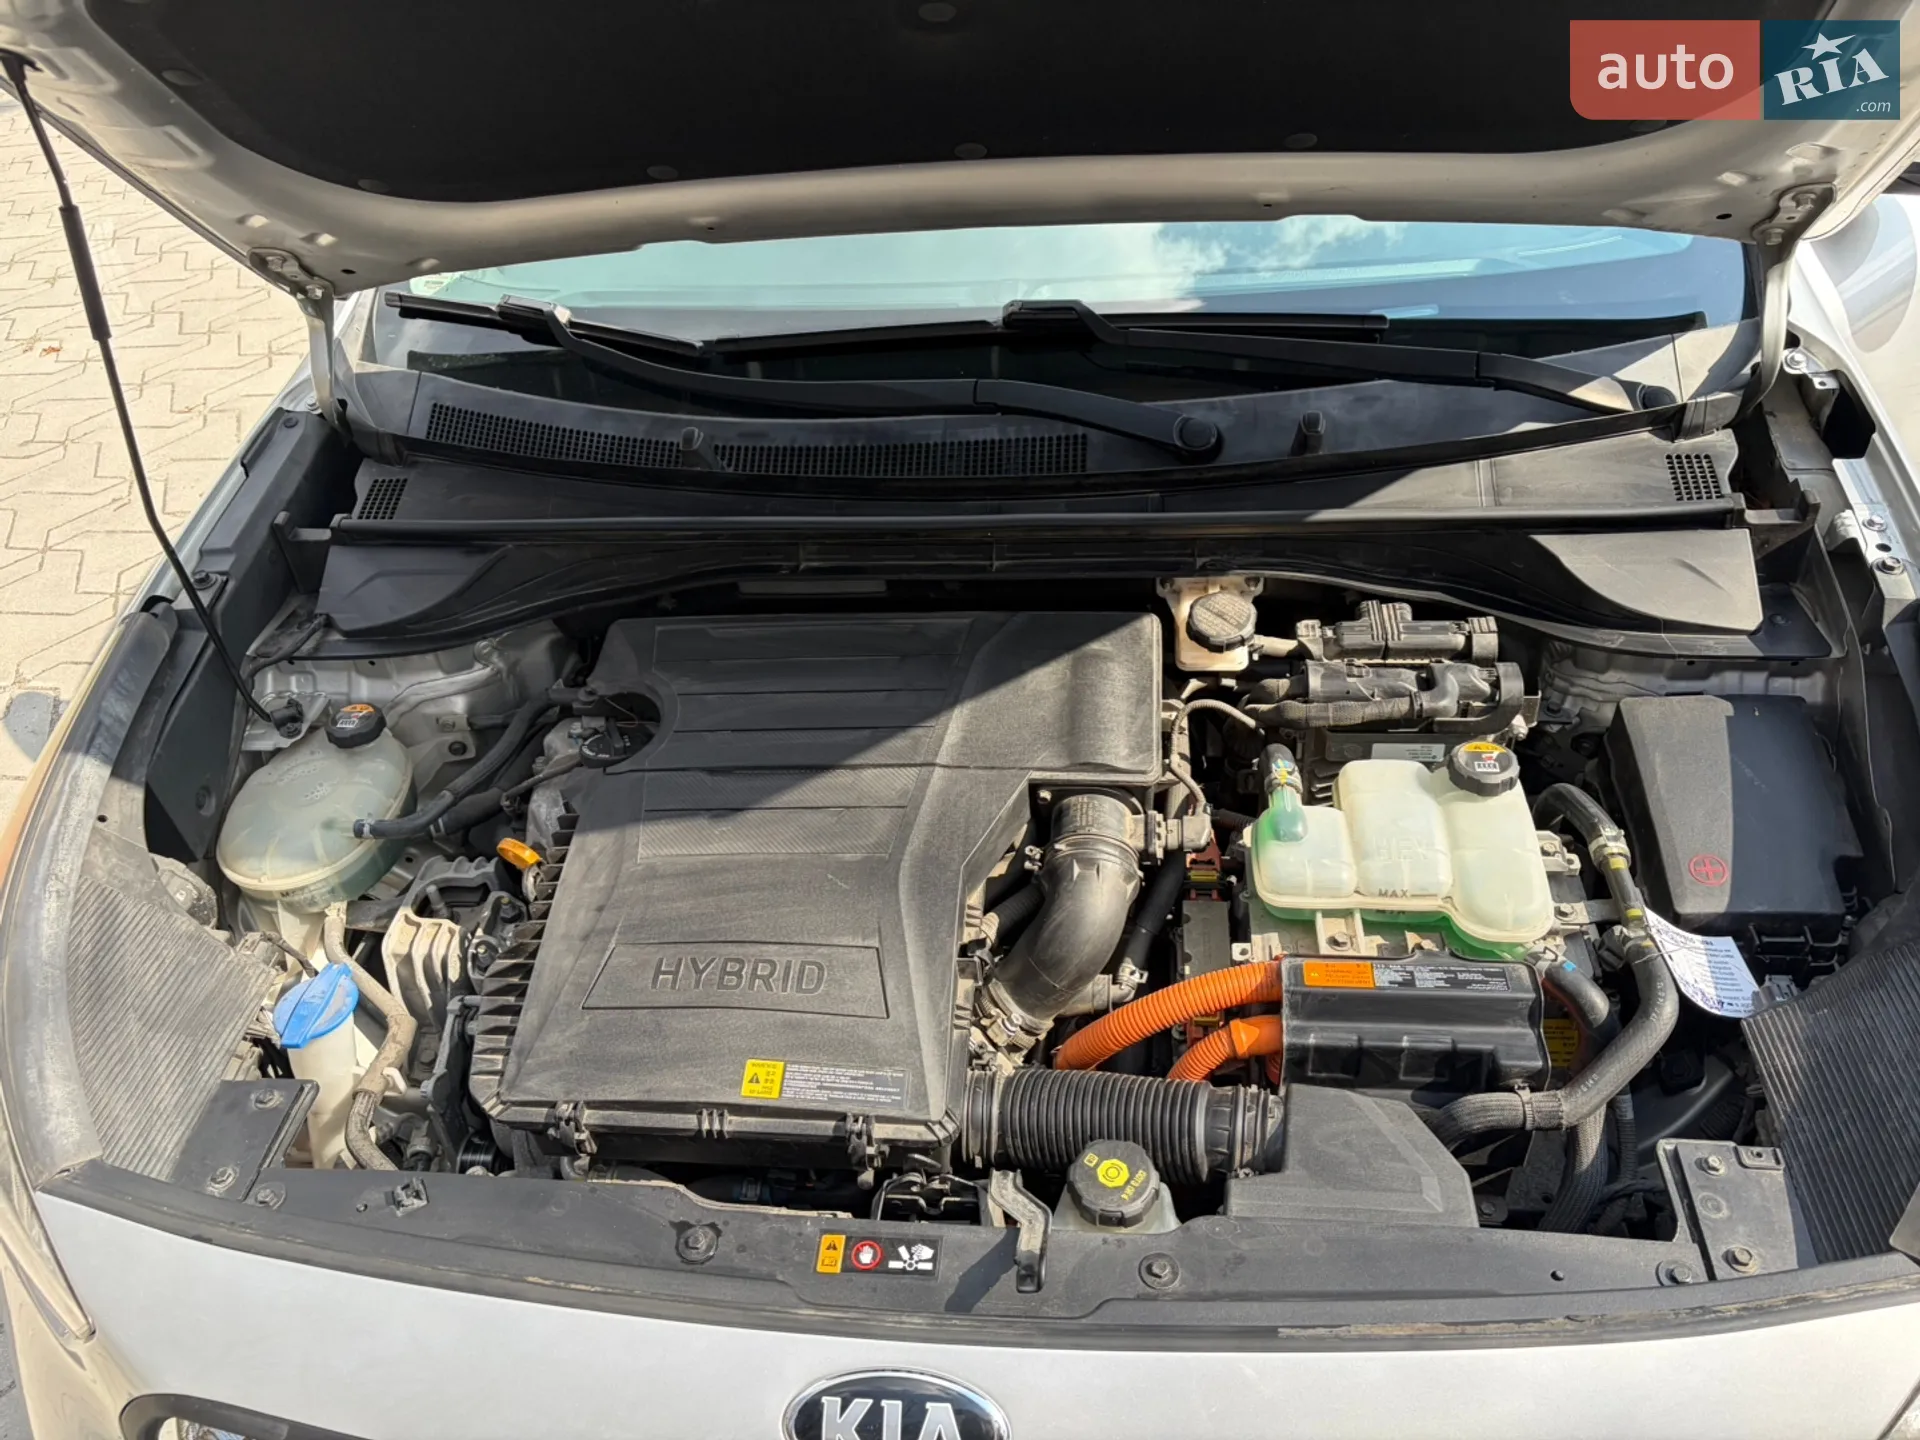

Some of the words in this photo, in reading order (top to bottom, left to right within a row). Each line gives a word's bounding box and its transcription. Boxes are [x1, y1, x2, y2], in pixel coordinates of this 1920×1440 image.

[1378, 887, 1409, 899] MAX
[650, 956, 827, 995] HYBRID
[821, 1396, 962, 1440] KIA
